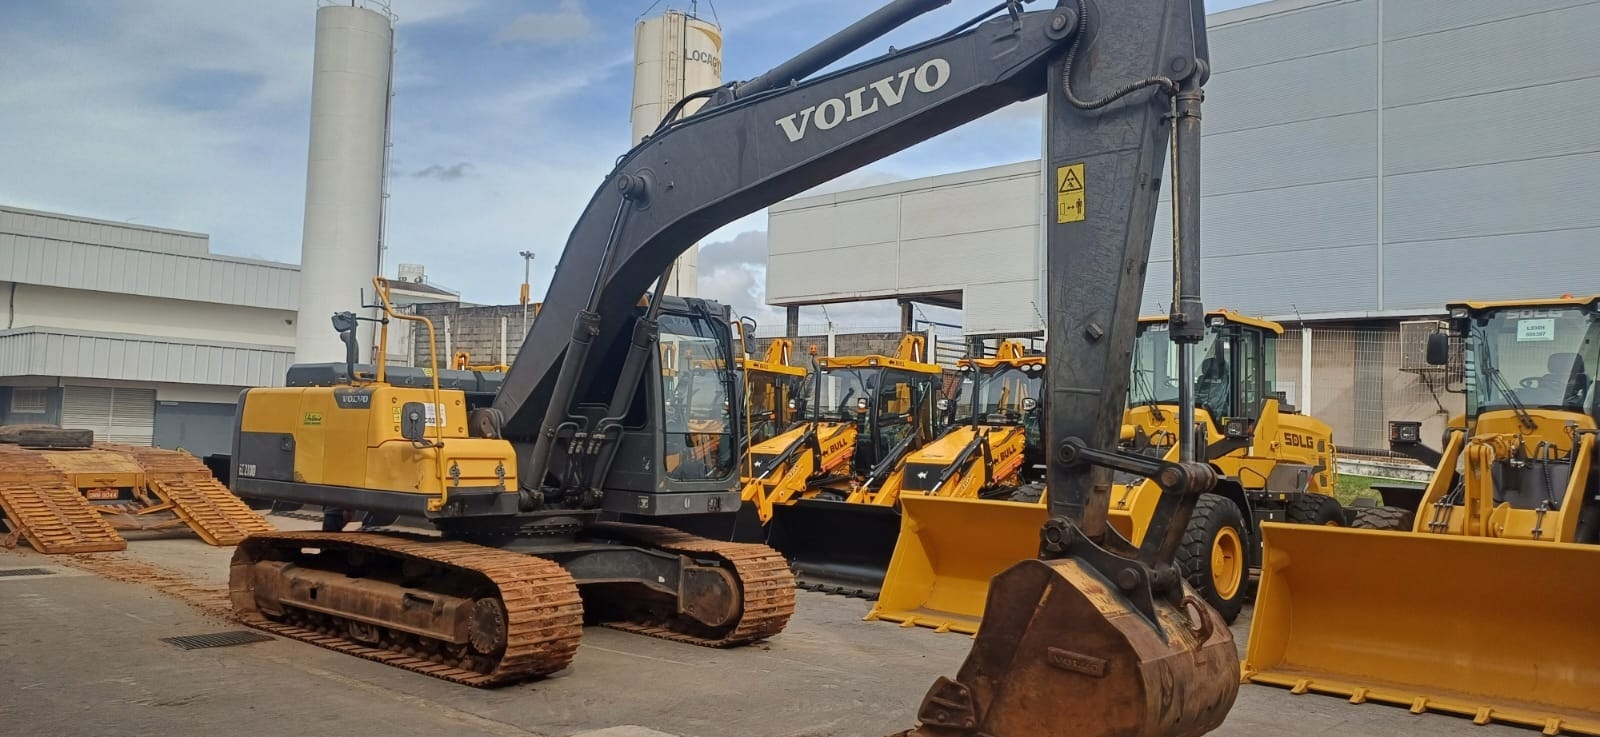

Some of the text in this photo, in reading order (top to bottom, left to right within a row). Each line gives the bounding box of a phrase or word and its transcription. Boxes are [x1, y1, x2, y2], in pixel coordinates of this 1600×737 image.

[775, 58, 951, 142] VOLVO
[342, 395, 369, 403] VOLVO
[830, 438, 848, 453] BULL
[1284, 432, 1314, 449] SDLG
[999, 444, 1017, 461] BULL
